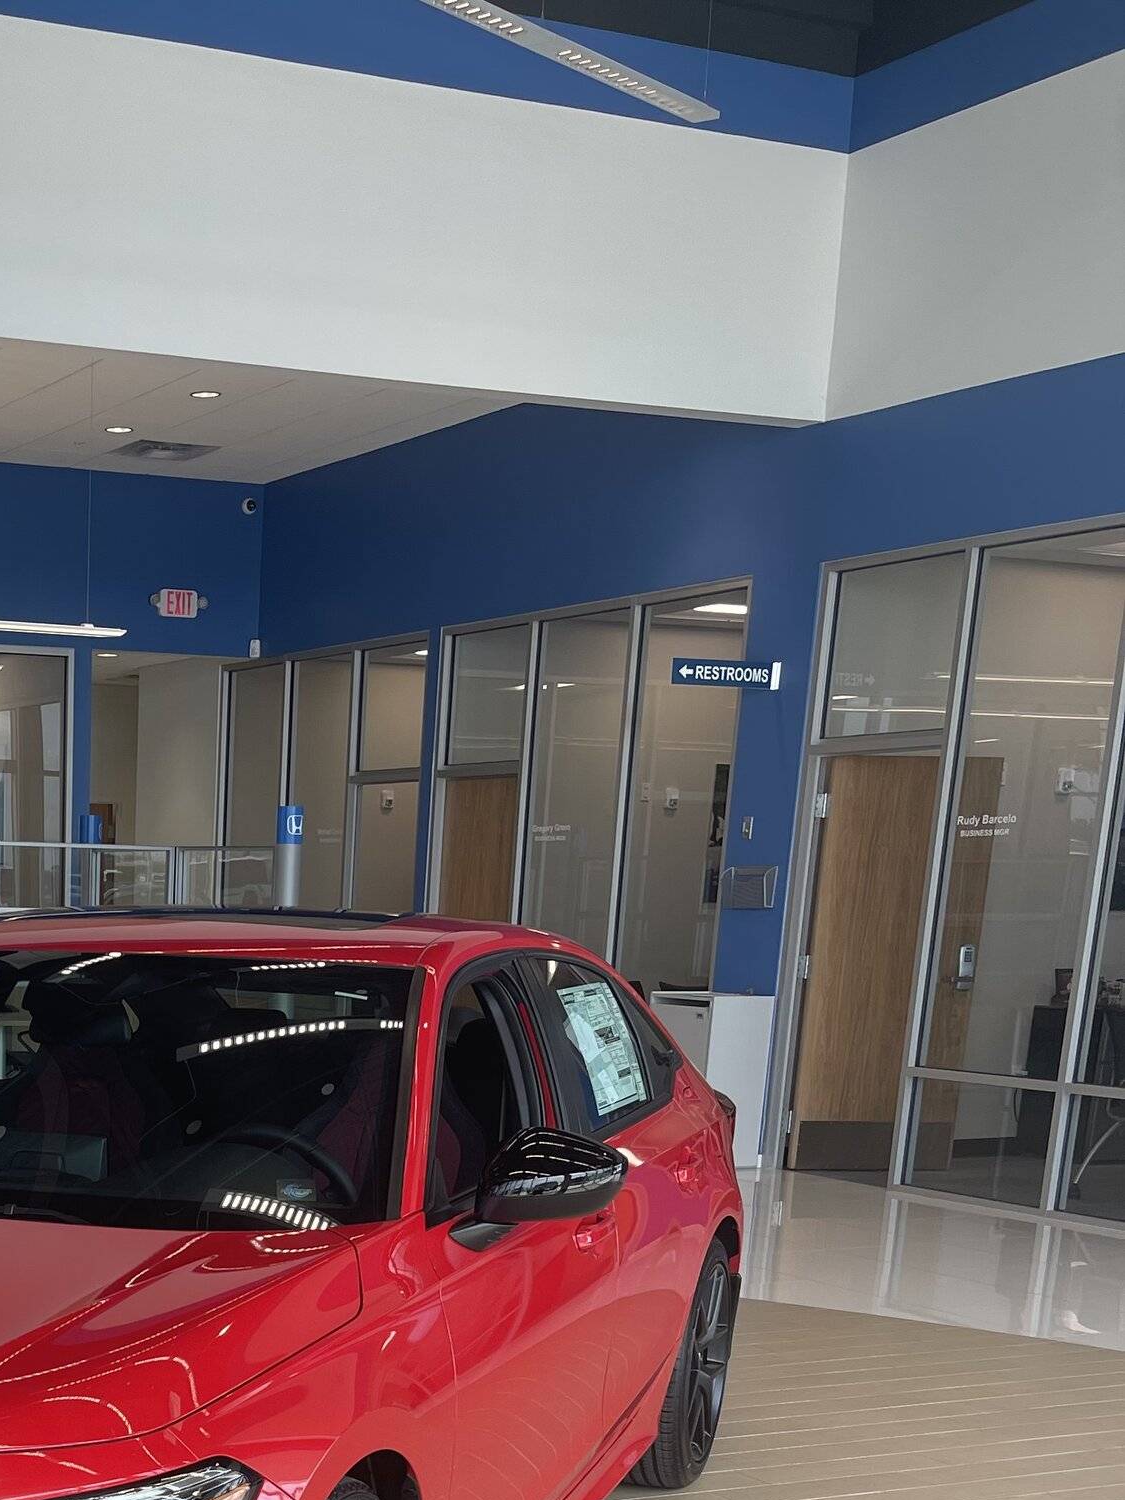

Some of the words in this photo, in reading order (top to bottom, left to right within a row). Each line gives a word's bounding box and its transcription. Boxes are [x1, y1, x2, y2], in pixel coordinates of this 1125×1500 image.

[167, 591, 193, 616] EXIT
[695, 665, 769, 684] RESTROOMS
[957, 815, 981, 827] Rudy
[960, 829, 993, 837] BUSINESS
